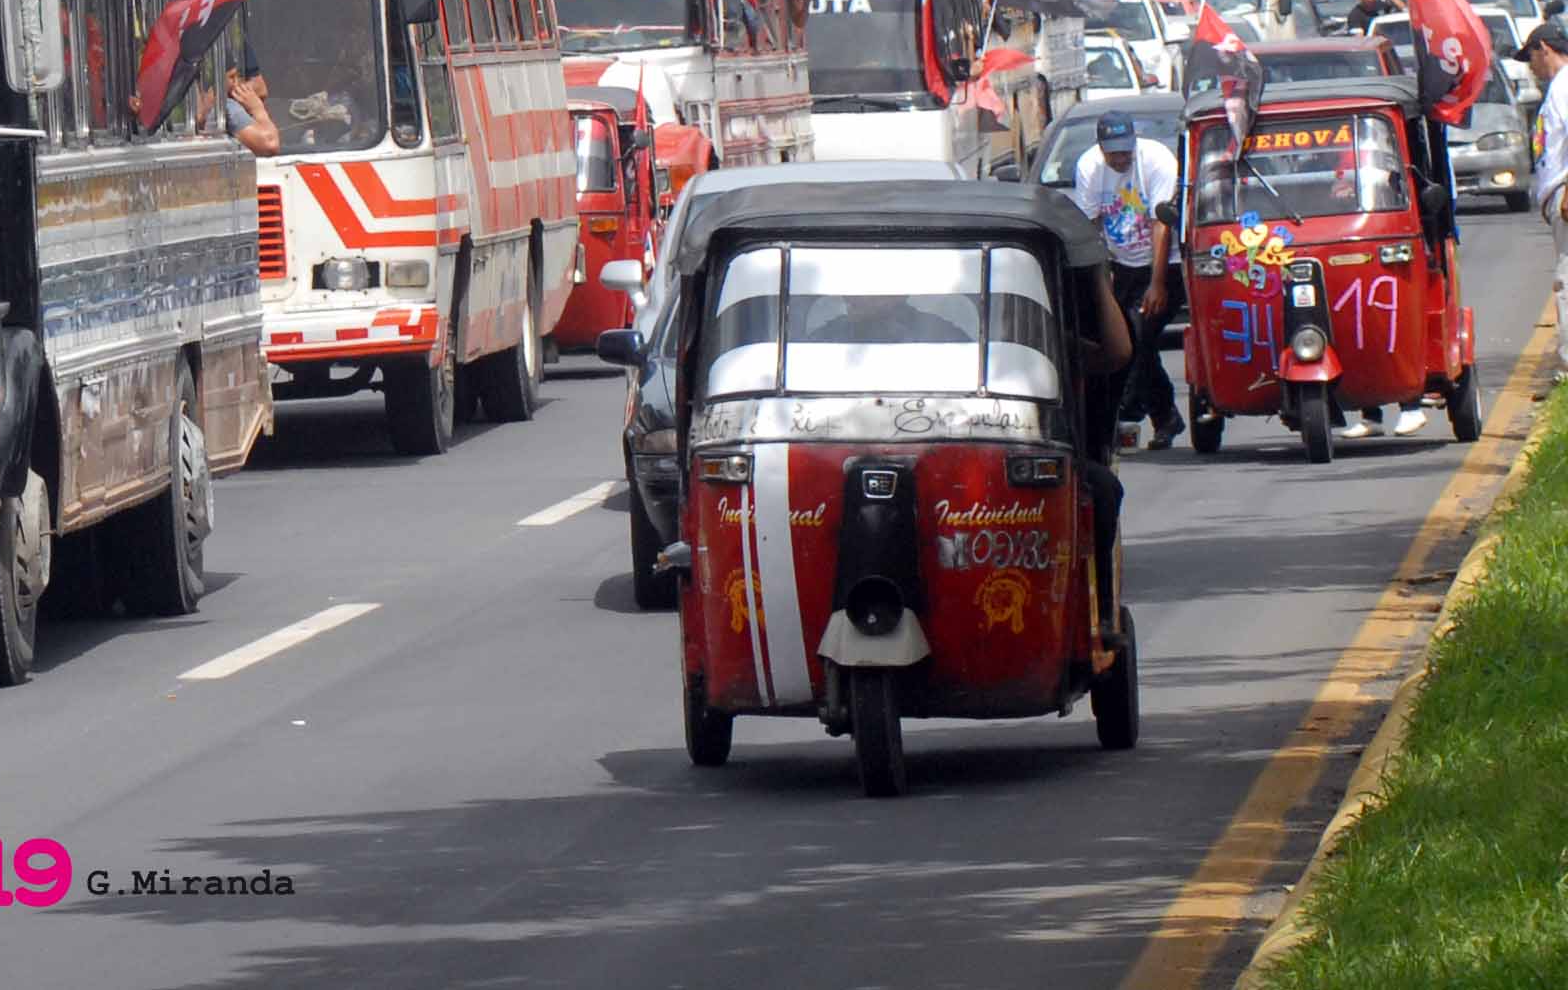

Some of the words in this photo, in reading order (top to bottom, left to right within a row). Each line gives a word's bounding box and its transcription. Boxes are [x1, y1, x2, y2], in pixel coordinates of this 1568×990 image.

[1222, 300, 1279, 371] 34
[1334, 275, 1418, 354] 19
[935, 497, 1045, 526] Individual
